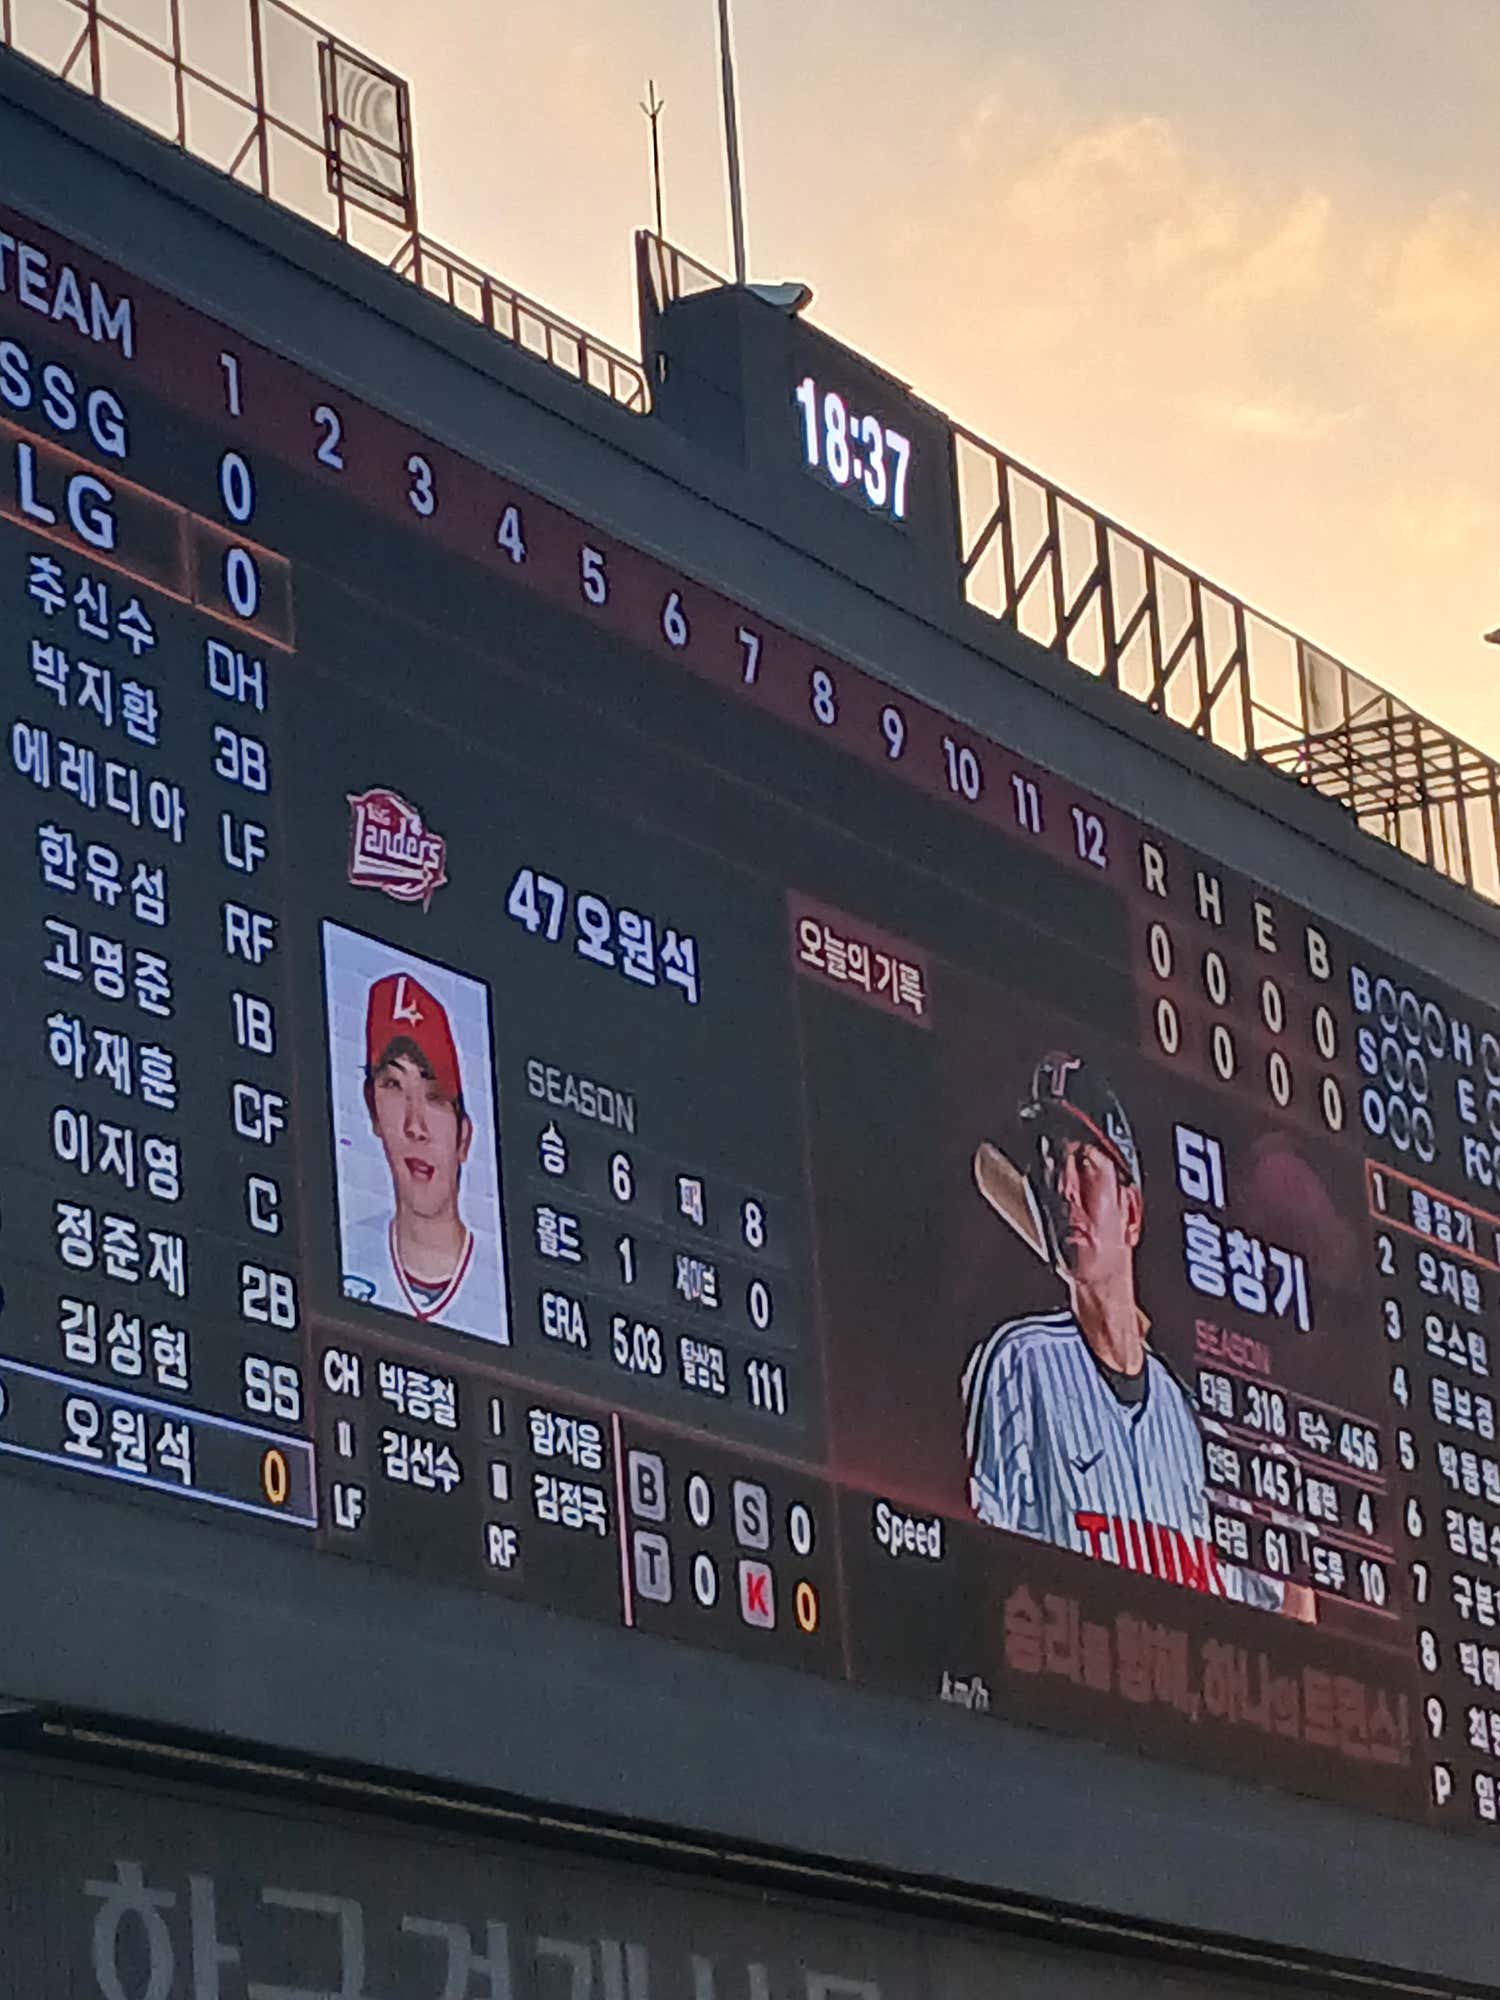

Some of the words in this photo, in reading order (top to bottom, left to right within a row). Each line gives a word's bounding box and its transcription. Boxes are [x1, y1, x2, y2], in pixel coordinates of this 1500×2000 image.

[797, 377, 910, 518] 18:37
[0, 233, 135, 358] TEAM
[220, 353, 241, 416] 1
[314, 405, 345, 470] 2
[407, 455, 435, 516] 3
[498, 507, 526, 562] 4
[582, 546, 607, 604] 5
[663, 592, 687, 646] 6
[739, 626, 760, 684] 7
[813, 670, 835, 725] 8
[882, 708, 904, 758] 9
[943, 736, 980, 800] 10
[1012, 773, 1041, 833] 11
[1072, 807, 1107, 868] 12
[1143, 842, 1167, 897] R
[1197, 872, 1222, 925] H
[1254, 902, 1277, 953] E
[1307, 927, 1330, 979] B
[29, 555, 156, 655] 추신수
[207, 640, 264, 711] DH
[0, 341, 128, 458] SSG
[221, 452, 252, 522] 0
[1151, 924, 1172, 978] 0
[1206, 952, 1227, 1005] 0
[1262, 980, 1283, 1033] 0
[1315, 1006, 1335, 1059] 0
[32, 640, 159, 745] 박지환
[215, 727, 267, 791] 3B
[12, 722, 187, 843] 에레디아
[222, 814, 265, 871] LF
[17, 442, 117, 550] LG
[227, 548, 258, 617] 0
[1158, 999, 1179, 1053] 0
[1214, 1026, 1235, 1079] 0
[1269, 1052, 1291, 1107] 0
[1323, 1078, 1343, 1131] 0
[39, 825, 166, 925] 한유섬
[225, 902, 273, 963] RF
[508, 869, 566, 941] 47
[576, 894, 698, 1004] 오원석
[44, 919, 172, 1016] 고명준
[233, 993, 272, 1053] 1B
[800, 920, 872, 993] 오늘의
[874, 953, 926, 1015] 기록
[1351, 966, 1372, 1014] B
[47, 1013, 177, 1109] 하재훈
[234, 1083, 284, 1143] CF
[1359, 1028, 1378, 1075] S
[1452, 1020, 1473, 1066] H
[528, 1059, 634, 1134] SEASON
[1457, 1079, 1477, 1124] E
[54, 1109, 180, 1201] 이지영
[249, 1176, 278, 1233] C
[541, 1120, 566, 1175] 승
[611, 1154, 633, 1201] 6
[744, 1201, 765, 1248] 8
[1175, 1124, 1225, 1209] 51
[1373, 1172, 1387, 1211] 1
[56, 1202, 186, 1297] 정준재
[243, 1265, 296, 1329] 2B
[535, 1207, 582, 1262] 홀드
[619, 1237, 633, 1284] 1
[750, 1282, 770, 1329] 0
[1183, 1210, 1312, 1332] 홍창기
[1379, 1235, 1395, 1275] 2
[60, 1299, 189, 1391] 김성현
[245, 1356, 300, 1421] SS
[542, 1292, 588, 1349] ERA
[613, 1317, 664, 1375] 5.03
[747, 1359, 785, 1415] 111
[1385, 1300, 1401, 1340] 3
[324, 1350, 361, 1397] CH
[379, 1361, 457, 1428] 박종철
[529, 1408, 603, 1470] 함지웅
[1393, 1367, 1409, 1408] 4
[64, 1398, 192, 1486] 오원석
[264, 1449, 288, 1503] 0
[382, 1430, 461, 1492] 김선수
[534, 1474, 606, 1536] 김정국
[1340, 1423, 1379, 1473] 456
[1399, 1430, 1415, 1470] 5
[334, 1484, 362, 1529] LF
[488, 1524, 517, 1567] RF
[637, 1464, 658, 1507] B
[688, 1475, 711, 1528] 0
[743, 1494, 762, 1537] S
[790, 1504, 813, 1556] 0
[876, 1501, 942, 1560] Speed
[1251, 1456, 1290, 1506] 145
[1358, 1493, 1374, 1536] 4
[1407, 1498, 1422, 1537] 6
[640, 1546, 662, 1587] T
[694, 1554, 717, 1606] 0
[746, 1571, 769, 1618] K
[796, 1581, 817, 1632] 0
[1264, 1528, 1291, 1576] 61
[1359, 1559, 1386, 1606] 10
[1413, 1563, 1427, 1602] 7
[1453, 1575, 1500, 1627] 구본
[1421, 1631, 1437, 1672] 8
[1427, 1698, 1443, 1738] 9
[1434, 1766, 1451, 1805] P
